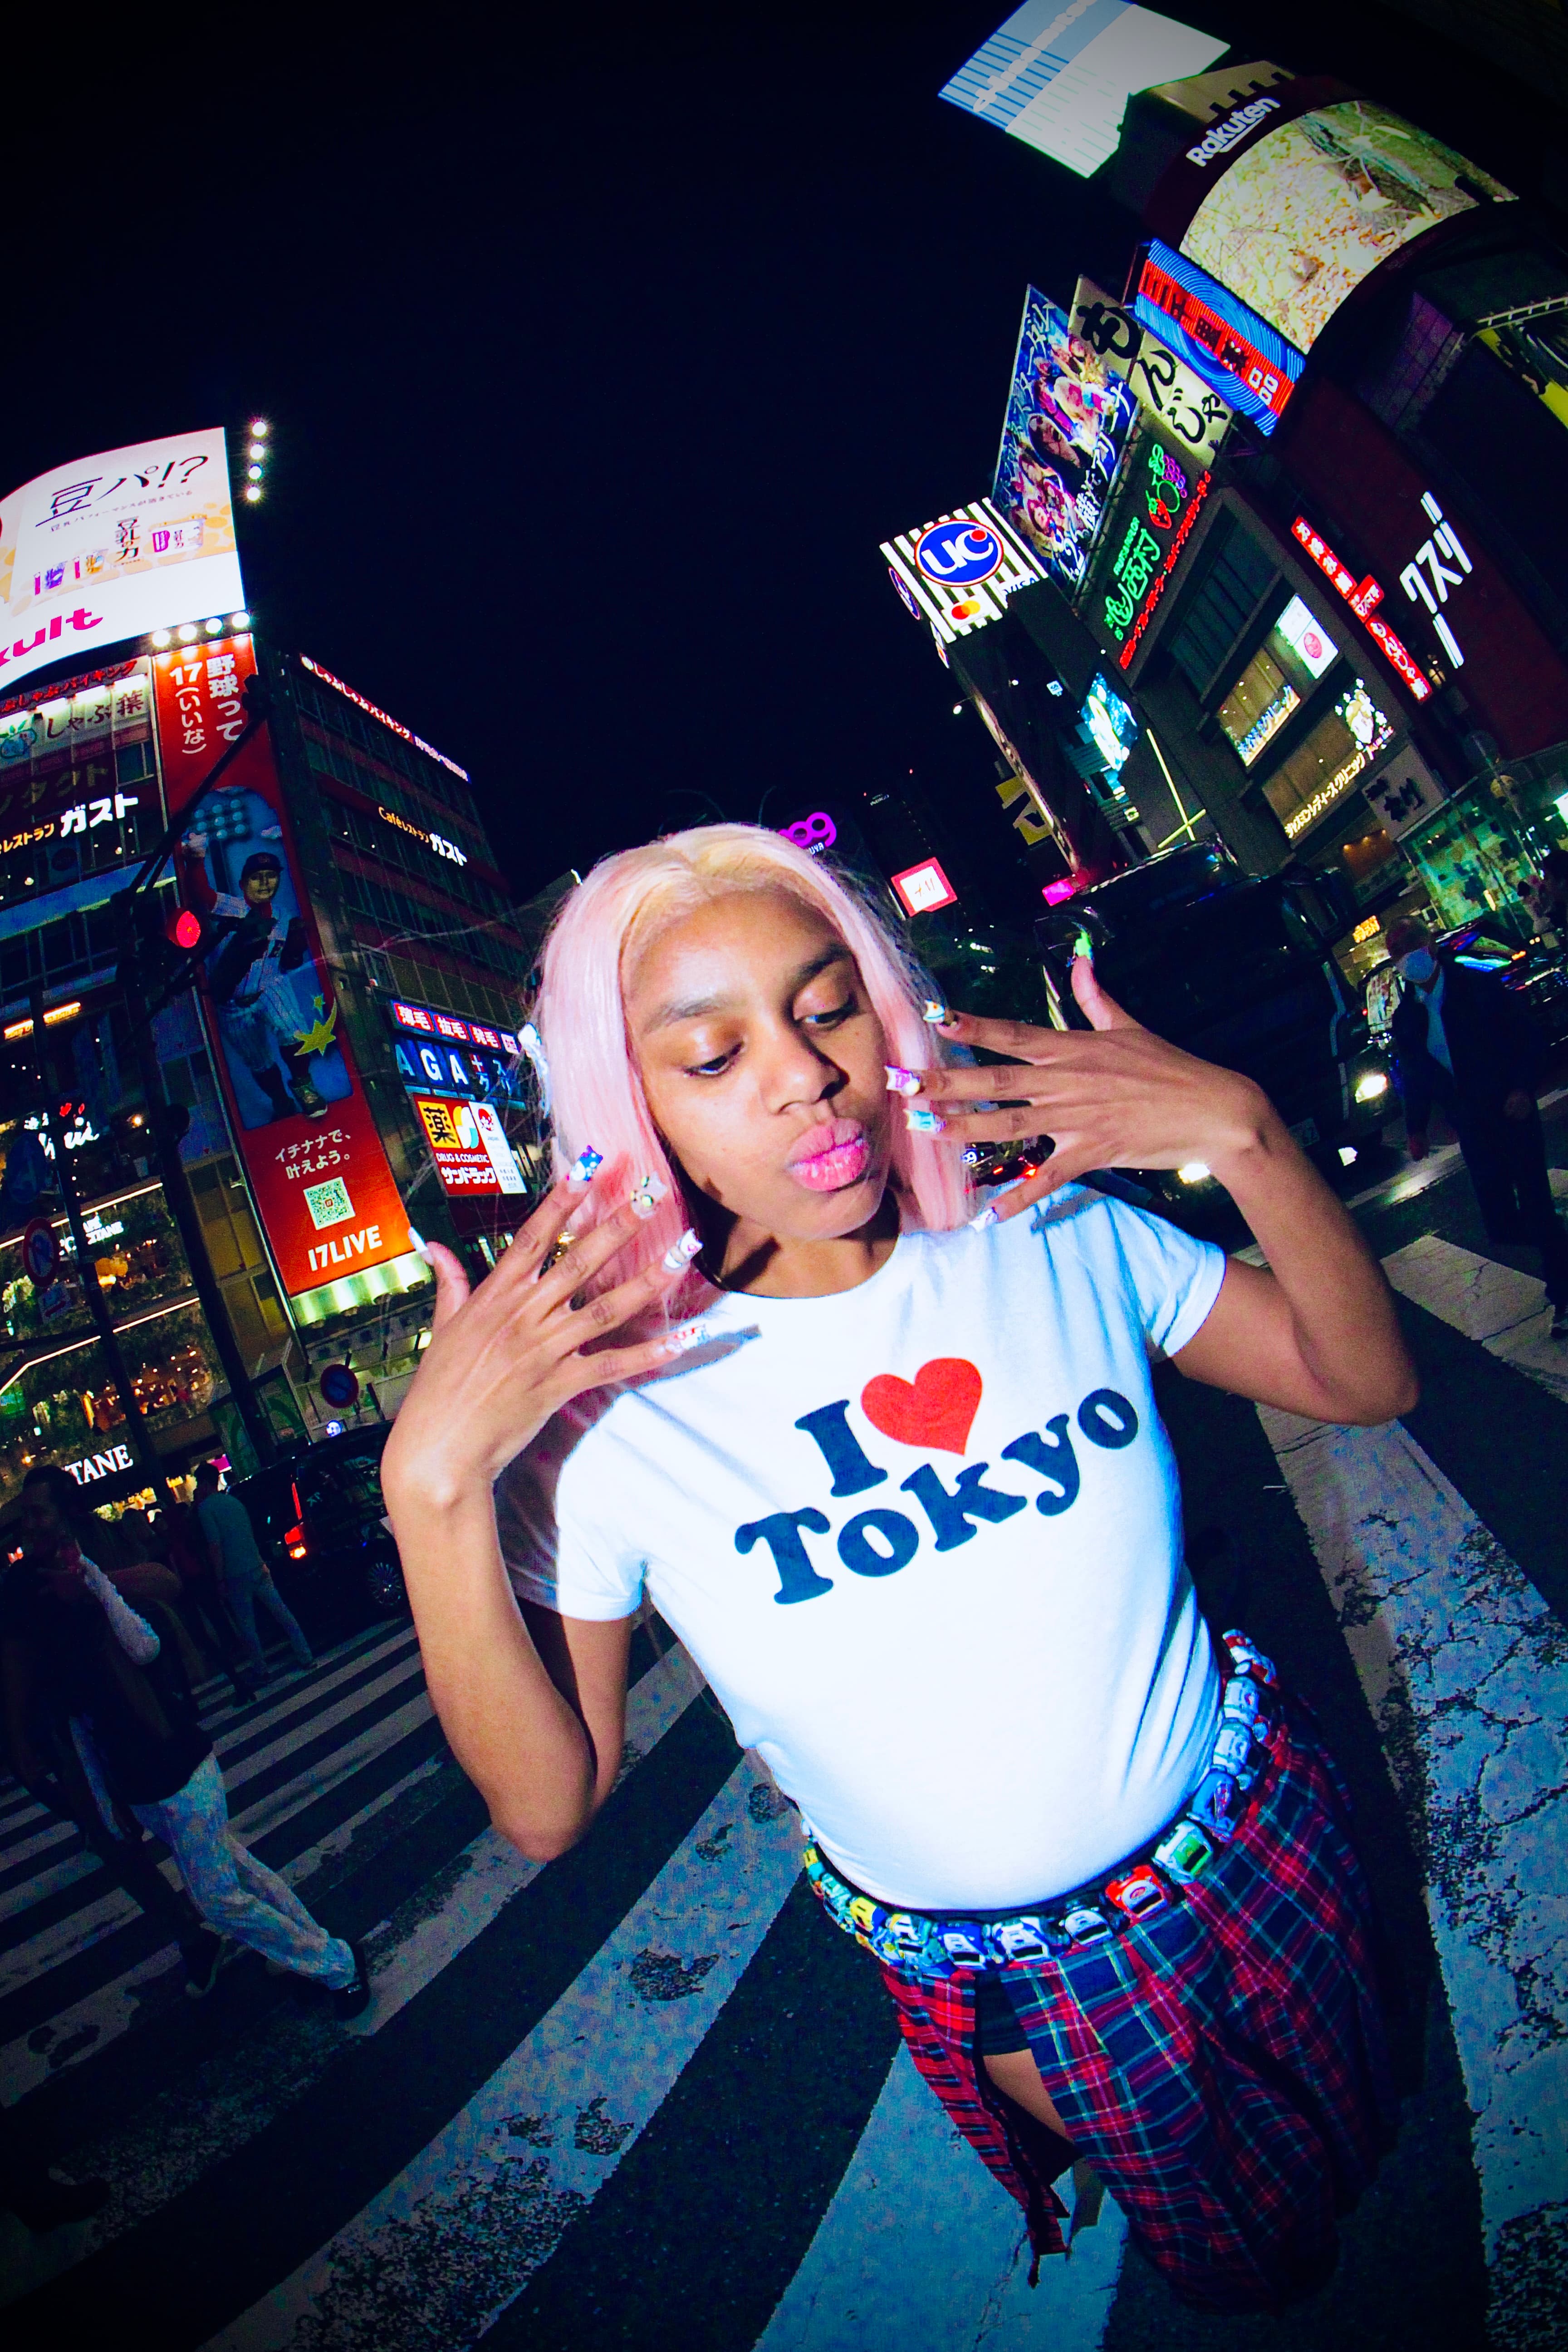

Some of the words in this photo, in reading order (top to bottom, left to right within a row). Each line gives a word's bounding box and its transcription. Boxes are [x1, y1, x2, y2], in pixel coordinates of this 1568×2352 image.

[1186, 98, 1281, 167] Rakuten
[35, 456, 209, 528] 豆パ!?
[921, 528, 994, 575] UC
[1122, 527, 1160, 600] 西村
[1399, 520, 1472, 614] クスリ
[206, 653, 242, 741] 野球って
[60, 793, 138, 838] ガスト
[778, 812, 837, 850] 09
[429, 833, 468, 866] ガスト
[395, 1044, 469, 1085] AGA
[275, 1129, 351, 1163] イチナナで、
[423, 1106, 456, 1144] 薬
[285, 1150, 350, 1180] 叶えよう。
[436, 1153, 454, 1162] DRUG
[460, 1153, 490, 1163] COSMETIC
[308, 1225, 383, 1271] 17LIVE
[794, 1399, 888, 1497] I
[734, 1387, 1139, 1605] Tokyo
